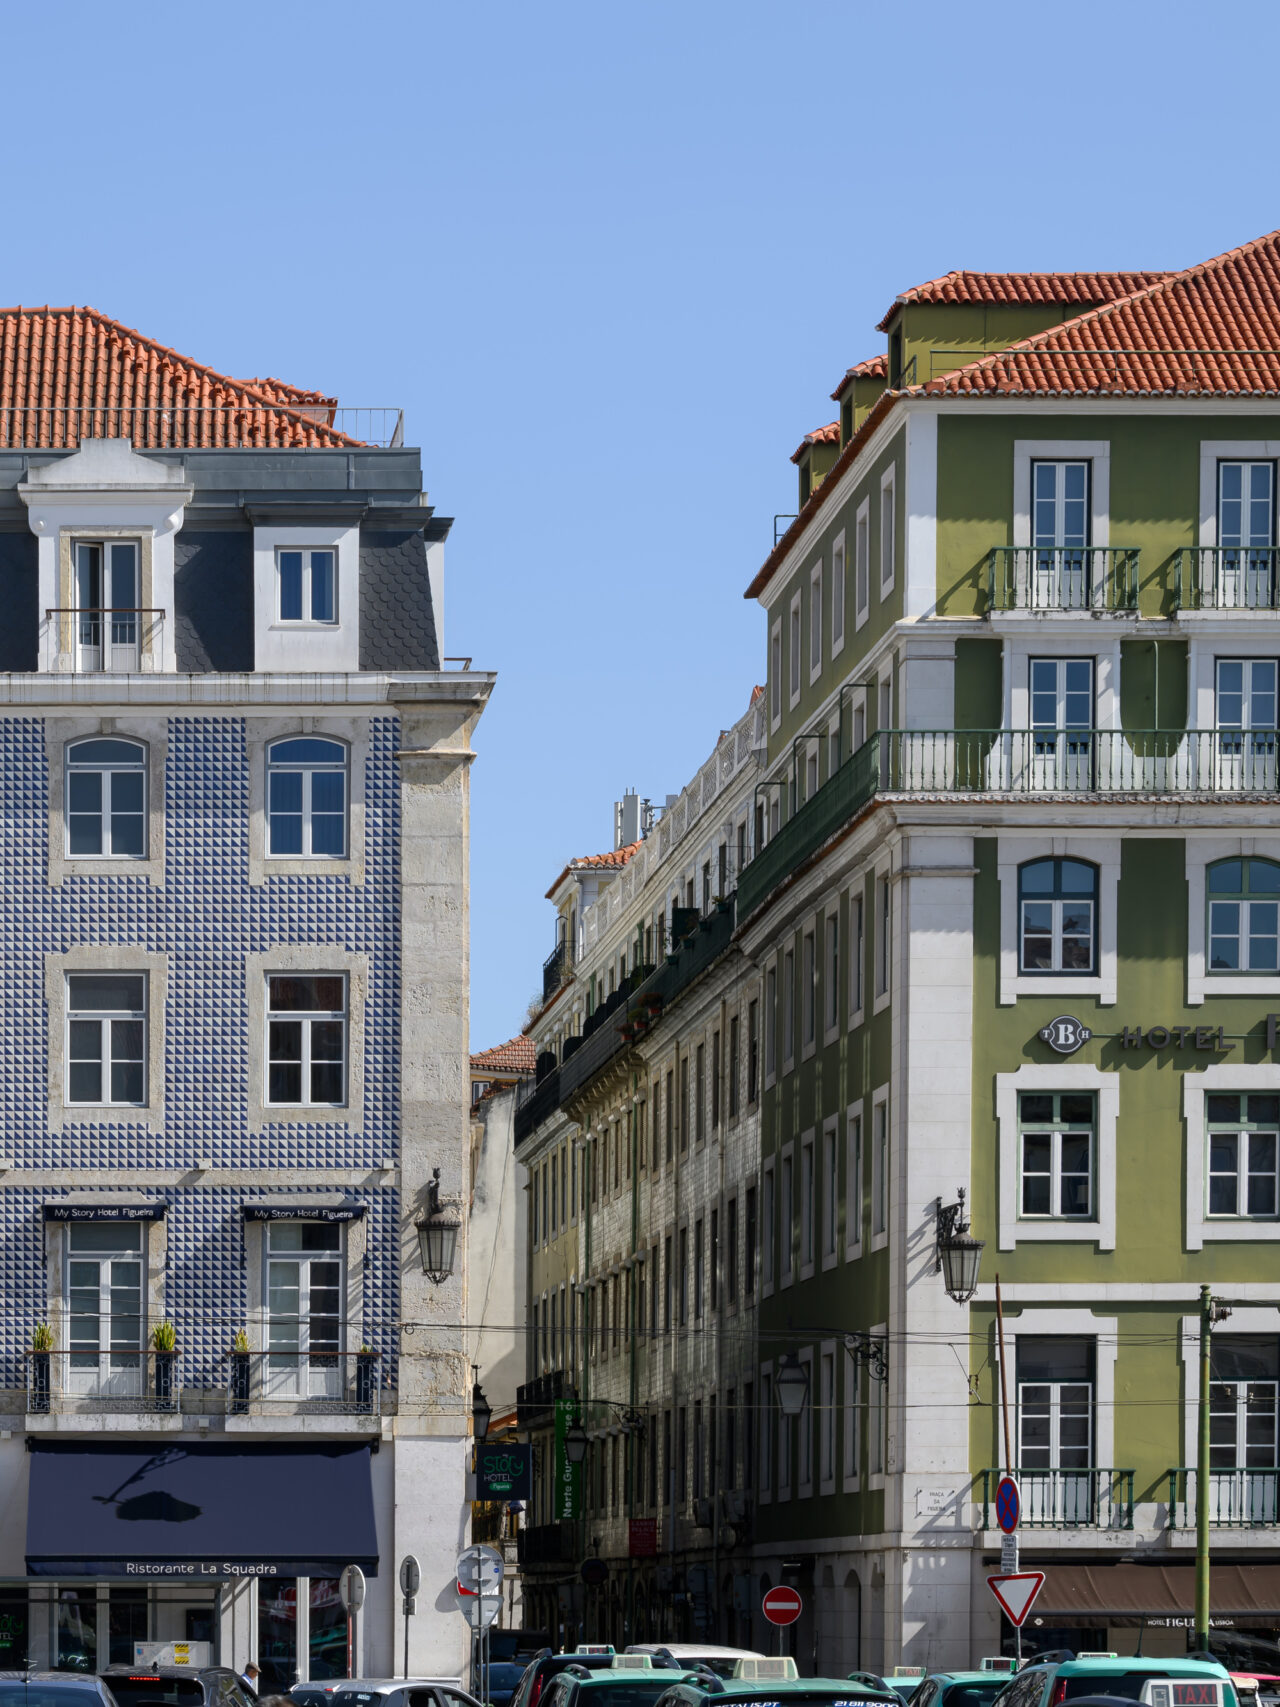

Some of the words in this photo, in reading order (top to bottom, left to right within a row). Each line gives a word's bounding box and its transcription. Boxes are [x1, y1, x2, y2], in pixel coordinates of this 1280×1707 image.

[1123, 1026, 1236, 1049] HOTEL
[54, 1209, 69, 1217] My
[71, 1209, 95, 1218] Story
[122, 1208, 154, 1218] Figueira
[254, 1210, 269, 1219] My
[271, 1210, 295, 1218] Story
[322, 1210, 353, 1219] Figueira
[483, 1473, 513, 1482] HOTEL
[563, 1485, 572, 1517] Norte
[126, 1563, 194, 1574] Ristorante
[201, 1563, 217, 1574] La
[223, 1563, 277, 1576] Squadra
[1165, 1618, 1215, 1627] FIGUEA
[1175, 1685, 1217, 1705] TAXI
